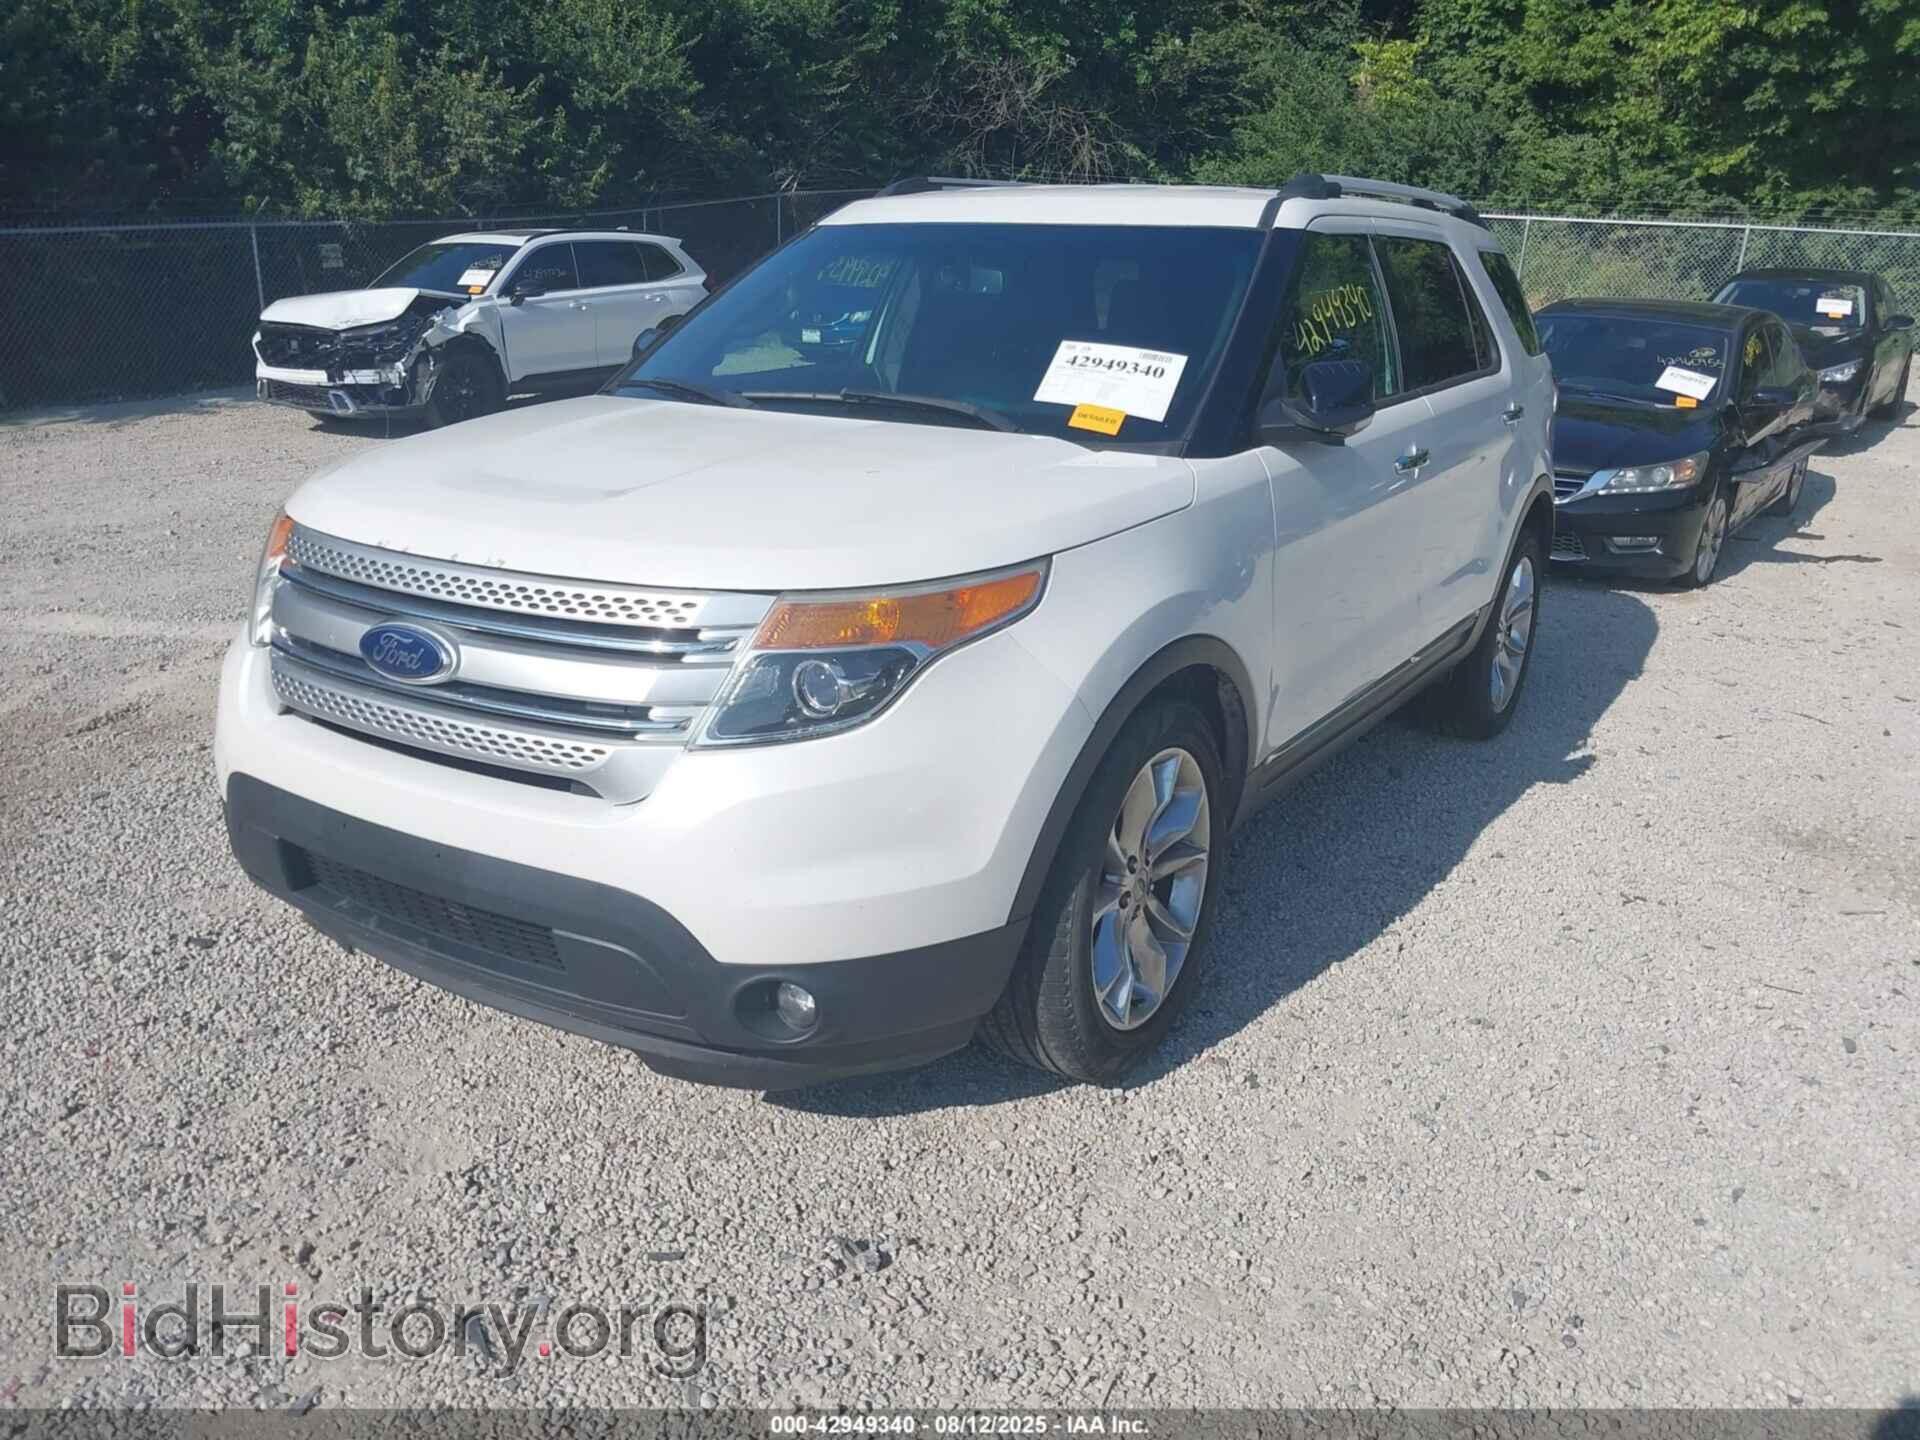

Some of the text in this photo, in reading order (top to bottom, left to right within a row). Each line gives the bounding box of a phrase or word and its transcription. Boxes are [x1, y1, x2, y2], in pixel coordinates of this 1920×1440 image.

[1292, 283, 1371, 356] 42949340
[1066, 355, 1165, 379] 42949340
[373, 632, 424, 669] Ford
